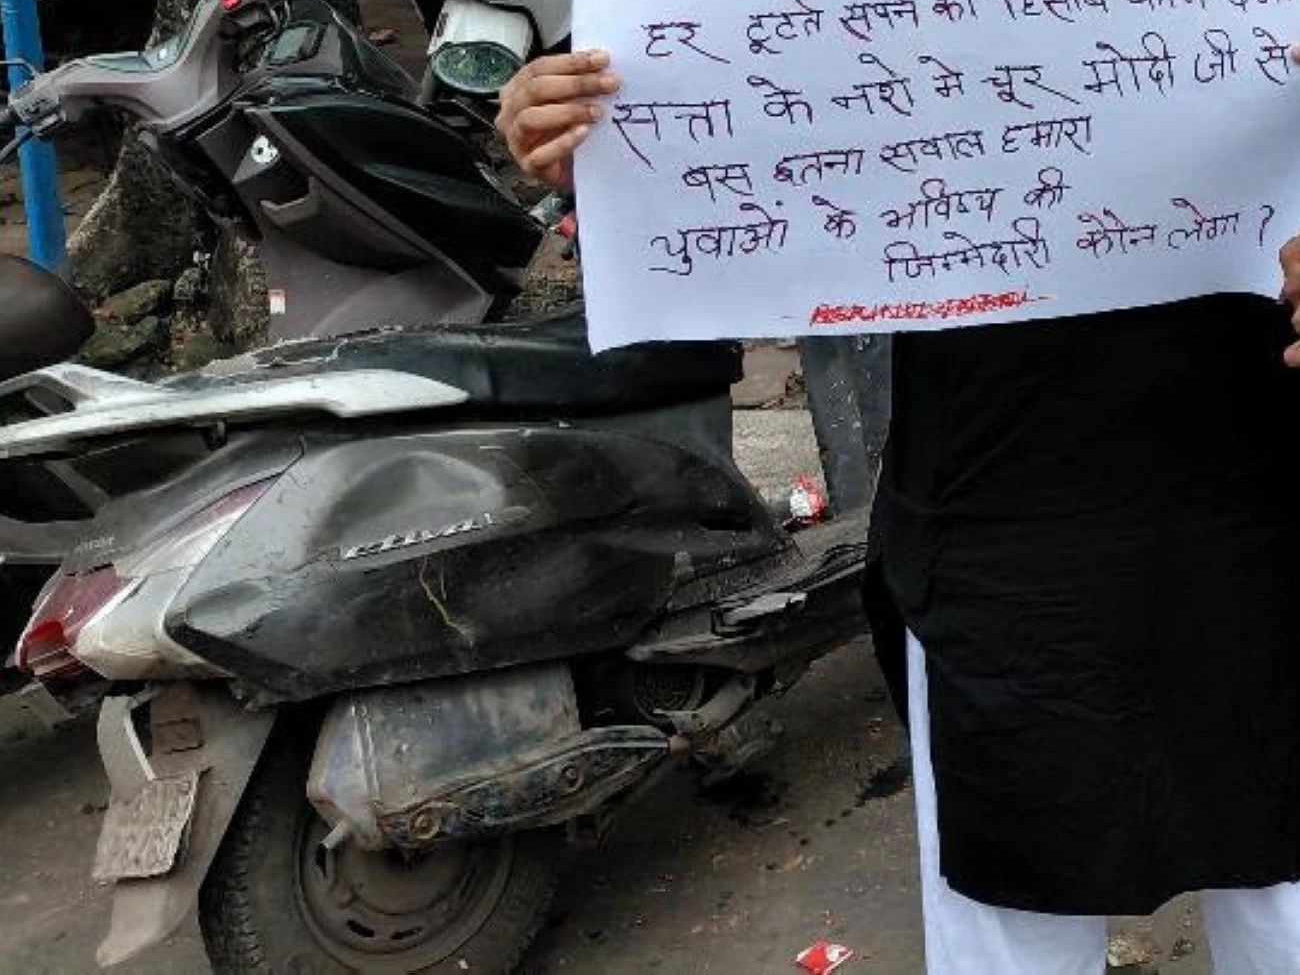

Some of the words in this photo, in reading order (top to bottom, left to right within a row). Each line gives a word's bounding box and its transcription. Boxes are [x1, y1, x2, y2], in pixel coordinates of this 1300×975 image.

[640, 21, 731, 64] हर
[746, 74, 814, 125] के
[980, 64, 1081, 110] चूर
[1081, 31, 1177, 98] मोदी
[1194, 27, 1240, 85] जी
[1252, 26, 1292, 86] से
[682, 162, 755, 204] बस
[879, 128, 985, 174] सवाल
[1001, 114, 1093, 156] हमारा
[811, 193, 858, 240] के
[1023, 166, 1073, 210] की
[1075, 207, 1158, 261] कौन
[1167, 196, 1240, 251] लेगा
[1253, 203, 1276, 248] ?
